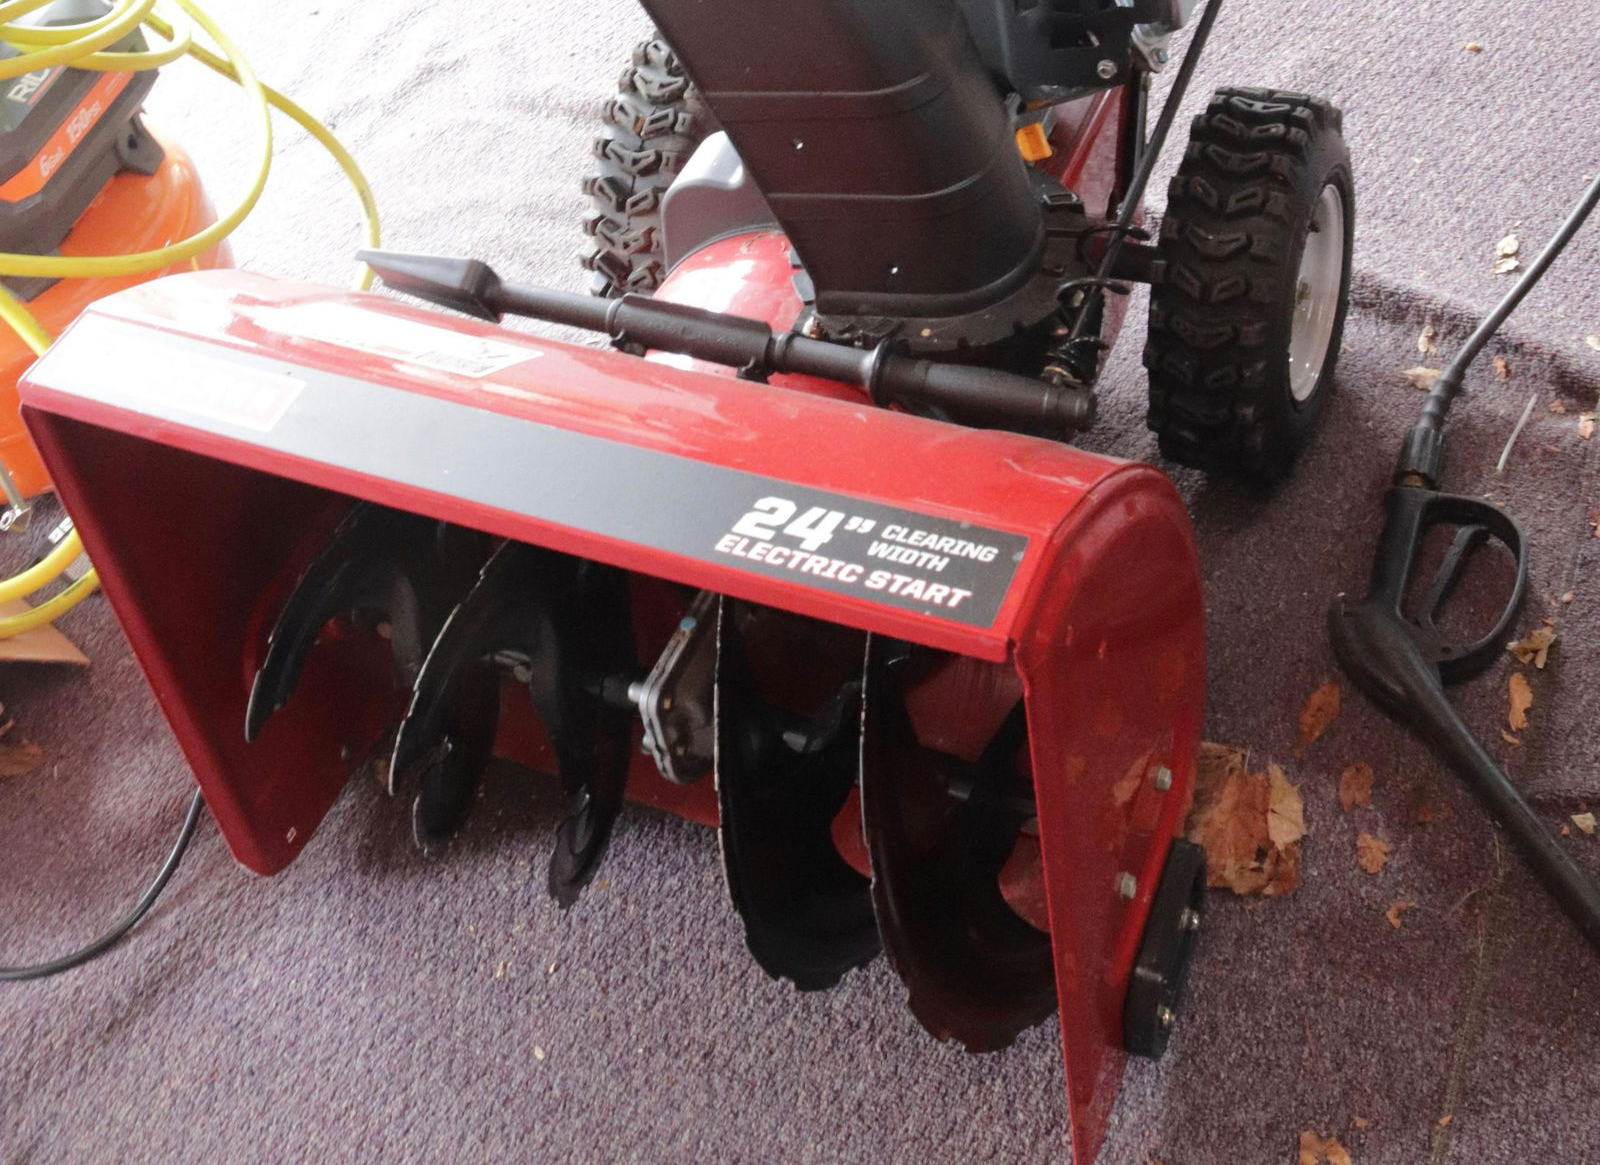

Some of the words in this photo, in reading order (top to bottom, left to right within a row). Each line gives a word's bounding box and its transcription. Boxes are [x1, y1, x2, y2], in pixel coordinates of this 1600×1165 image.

[866, 540, 950, 572] WIDTH
[881, 524, 999, 563] CLEARING
[714, 533, 864, 583] ELECTRIC
[864, 570, 973, 608] START
